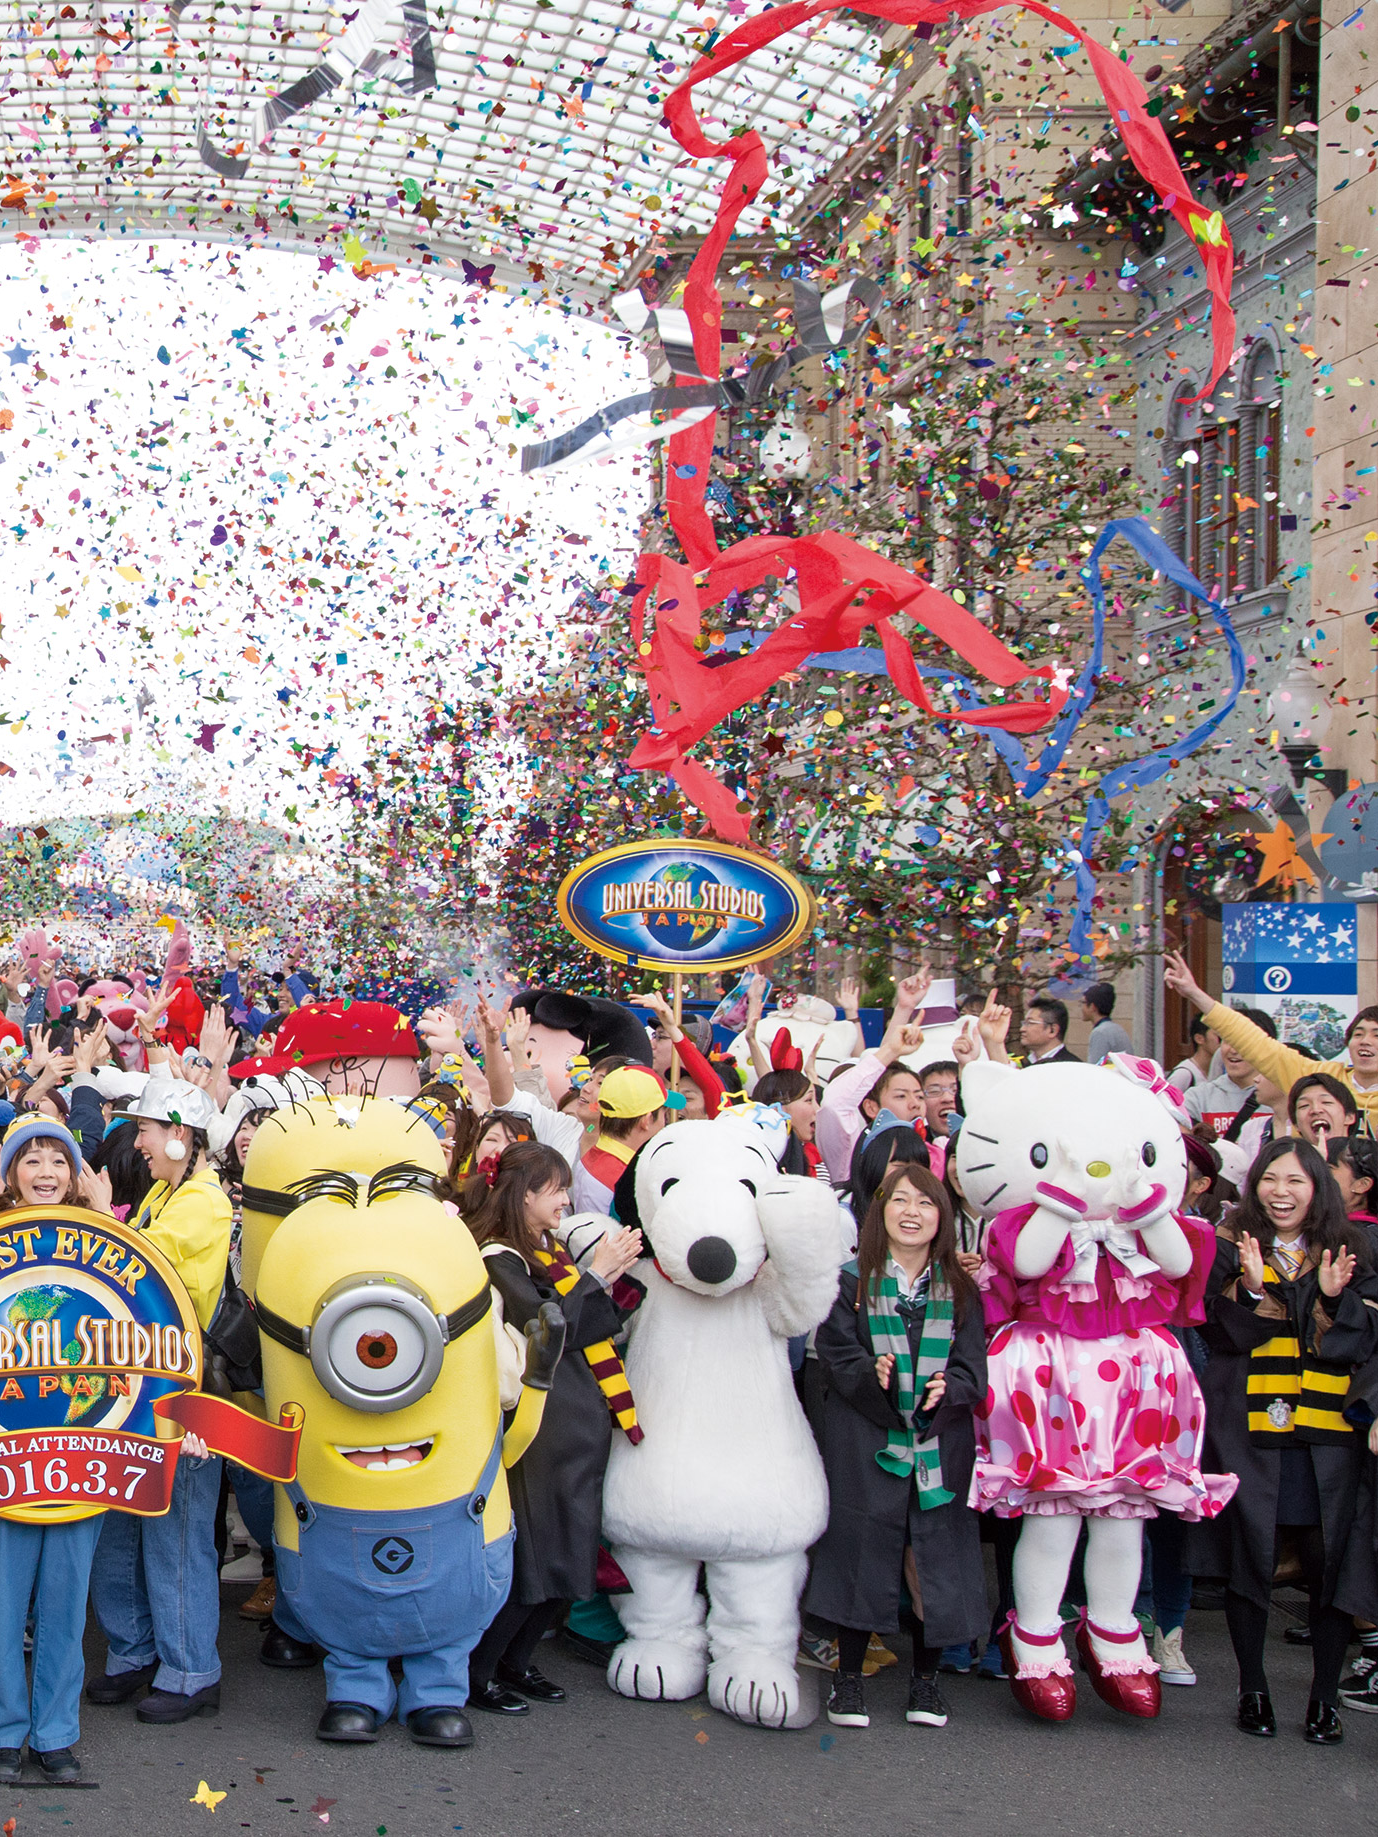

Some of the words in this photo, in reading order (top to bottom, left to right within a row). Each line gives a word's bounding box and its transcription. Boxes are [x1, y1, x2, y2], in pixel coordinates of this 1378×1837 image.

[602, 881, 696, 914] UNIVERSAL
[699, 880, 767, 920] STUDIOS
[639, 912, 728, 929] JAPAN
[52, 1226, 147, 1296] EVER
[74, 1315, 197, 1376] STUDIOS
[27, 1436, 165, 1464] ATTENDANCE
